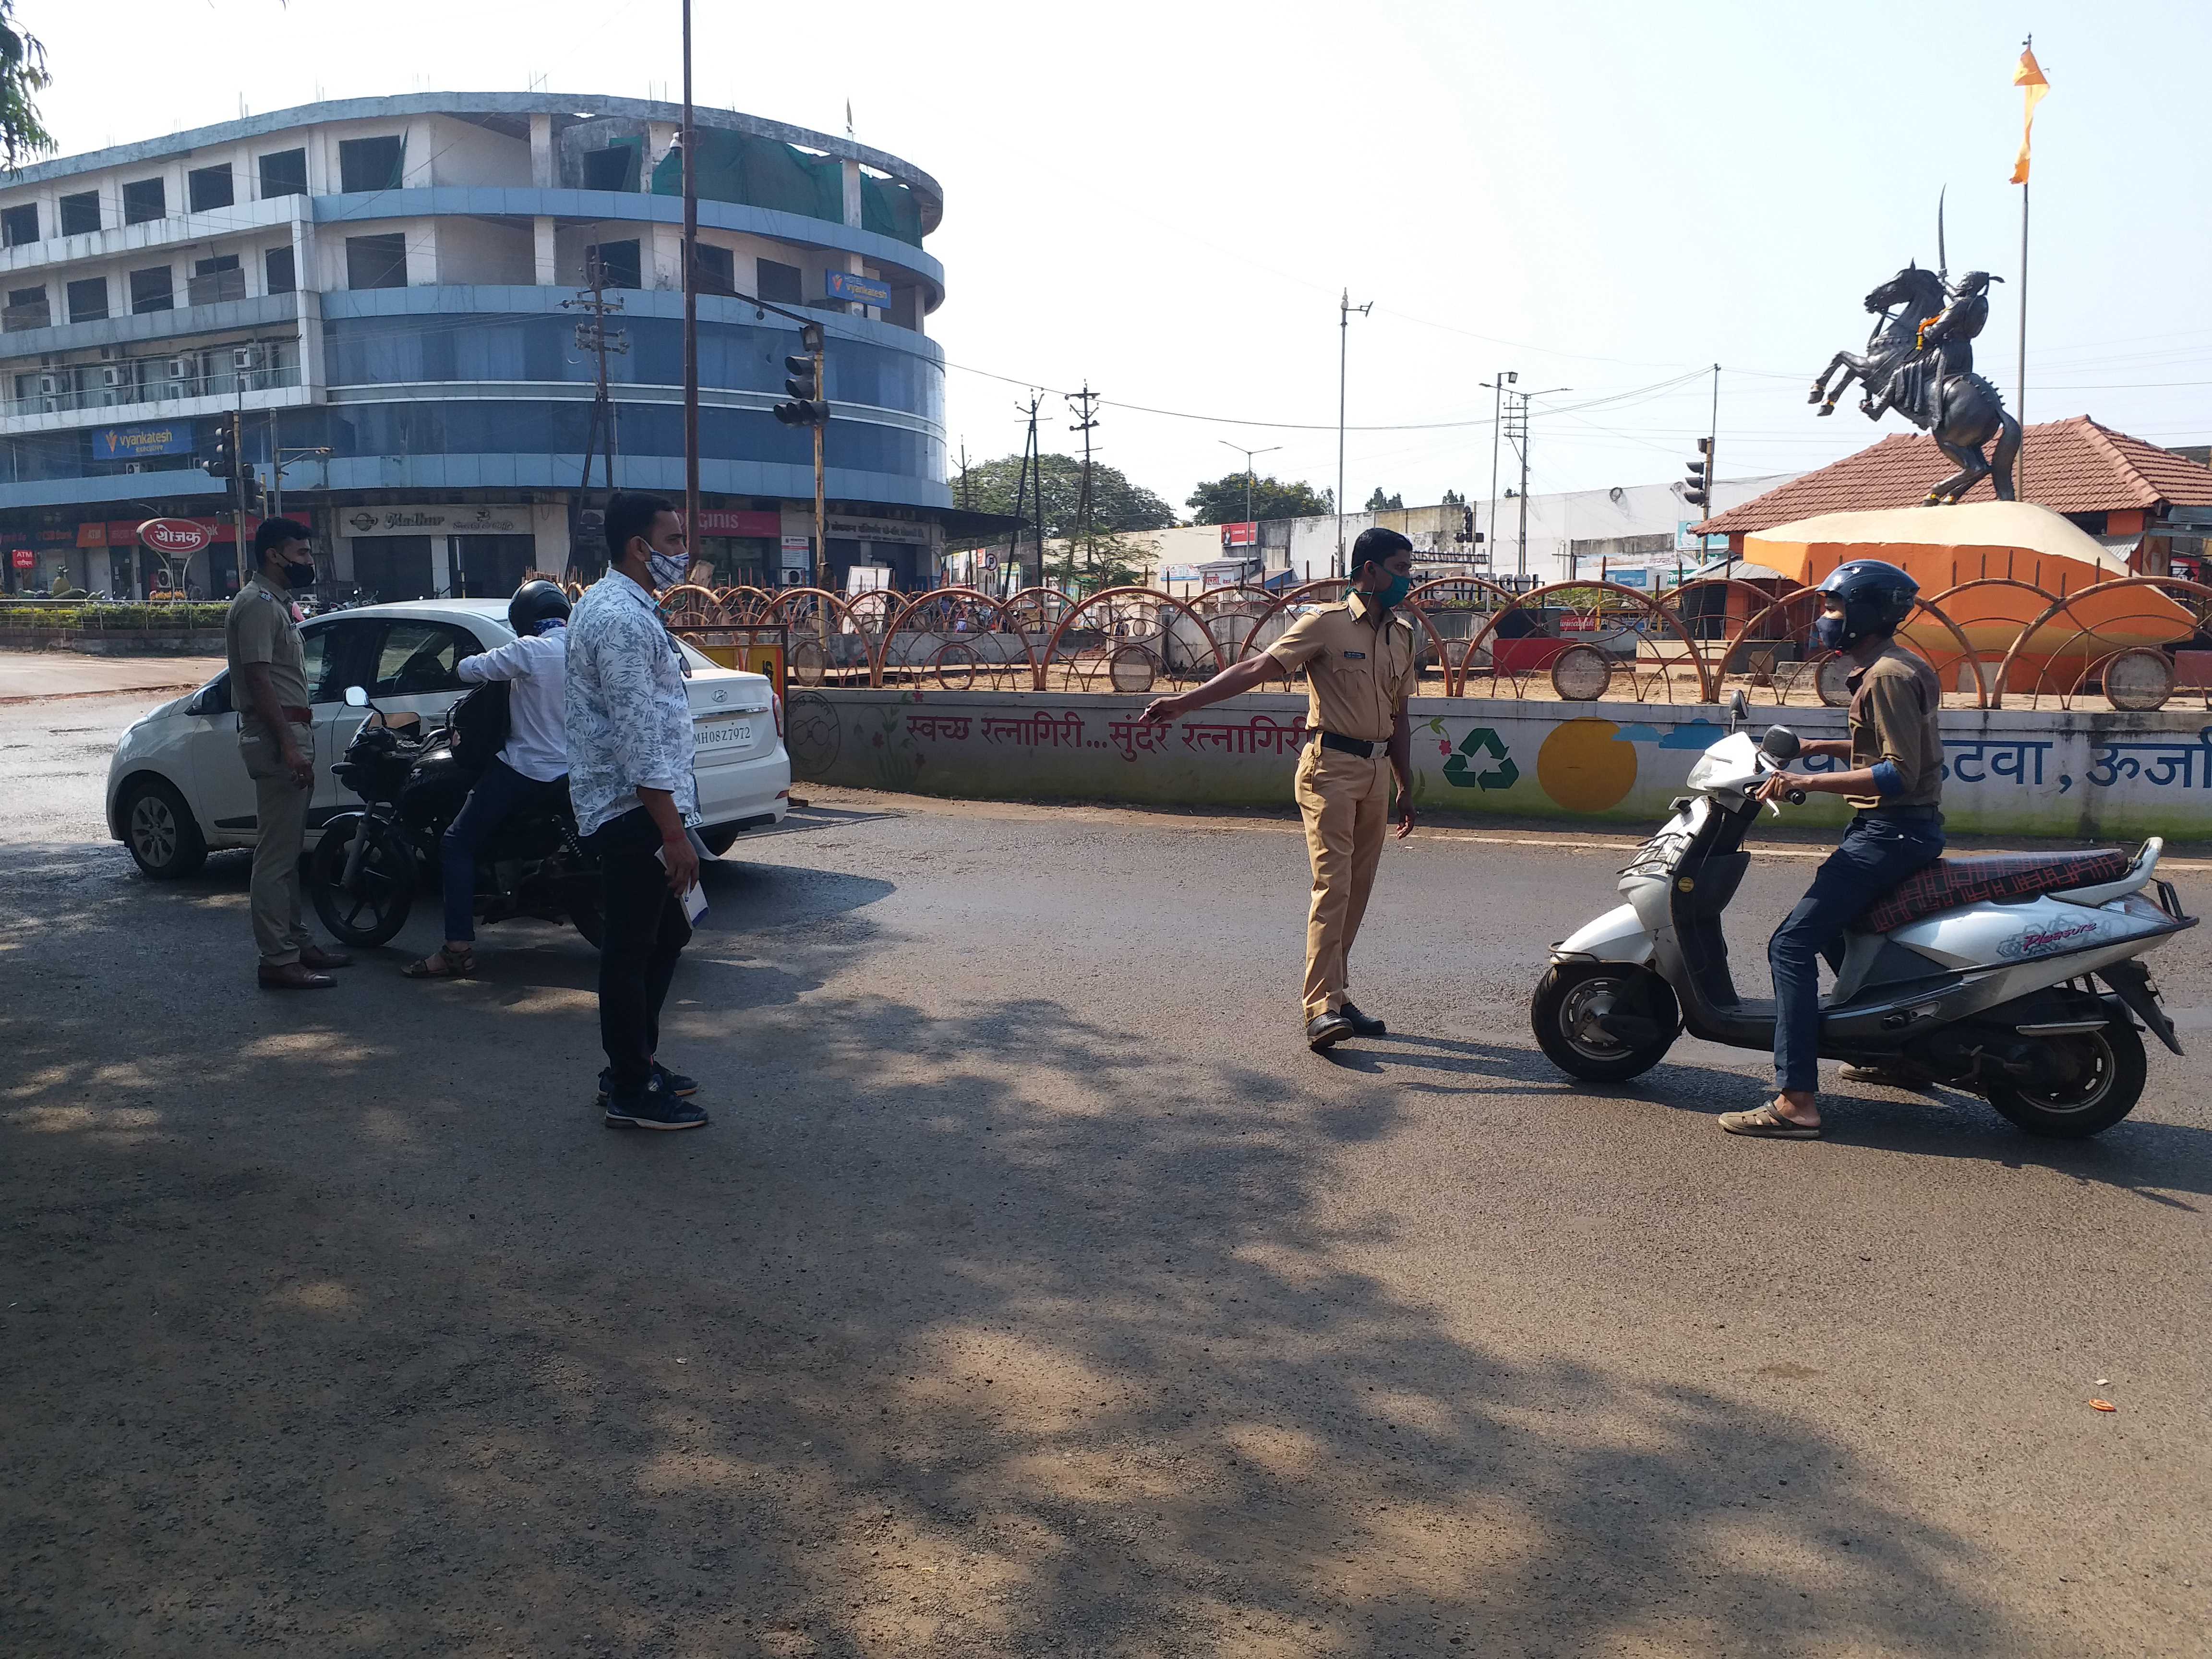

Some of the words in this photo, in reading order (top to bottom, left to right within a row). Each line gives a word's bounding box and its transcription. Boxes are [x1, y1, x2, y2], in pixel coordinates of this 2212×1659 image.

[120, 429, 172, 448] vyankatesh
[154, 524, 202, 543] योजक
[907, 715, 973, 742] स्वच्छ
[2022, 922, 2098, 952] Pleasure
